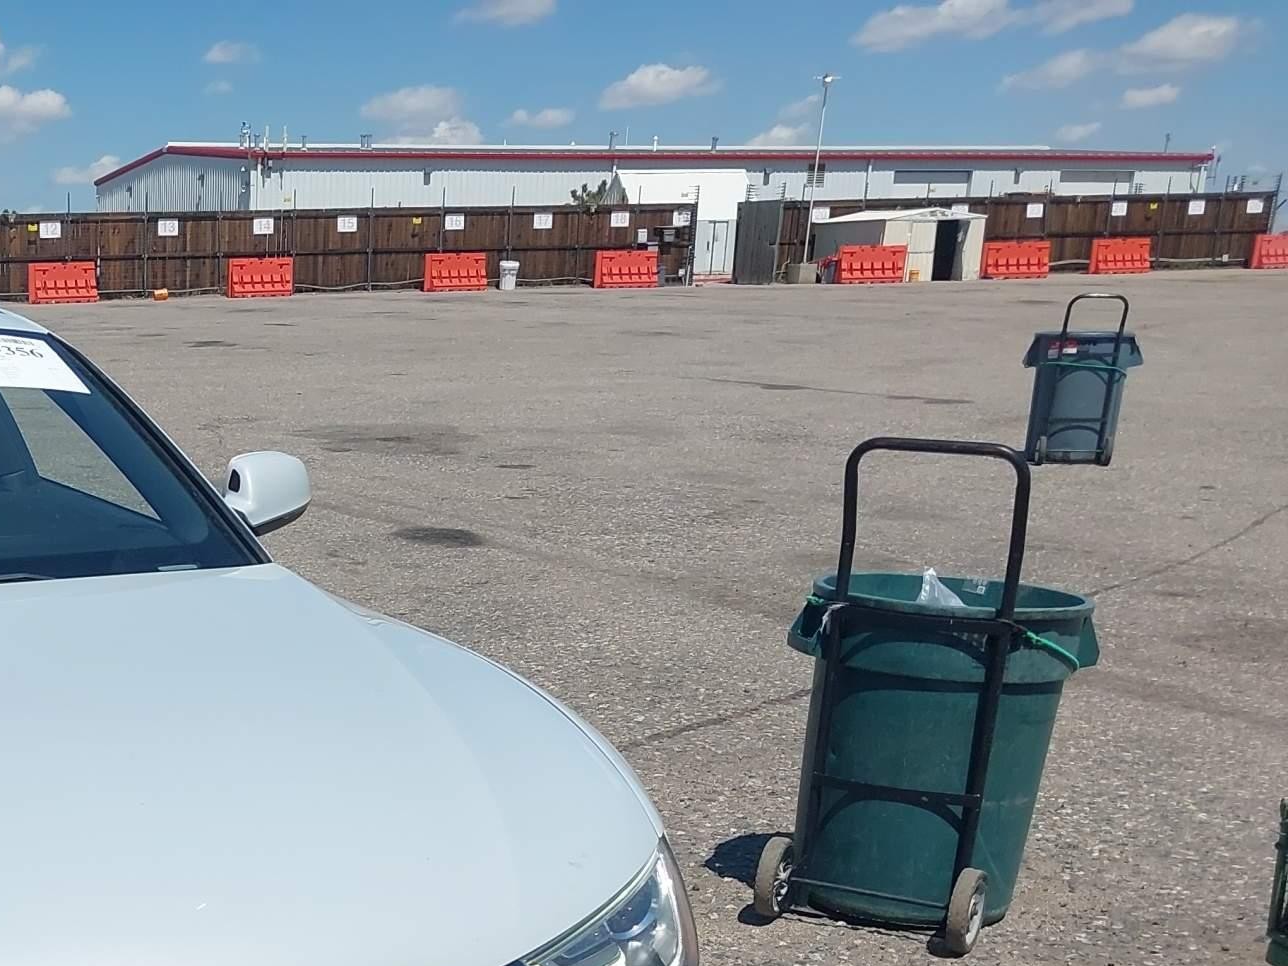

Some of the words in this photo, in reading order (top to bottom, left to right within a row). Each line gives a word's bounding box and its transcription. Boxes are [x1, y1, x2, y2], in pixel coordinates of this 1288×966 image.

[340, 218, 354, 229] 15
[447, 216, 461, 227] 16
[537, 215, 550, 225] 17
[44, 223, 58, 236] 12
[160, 222, 175, 233] 13
[258, 220, 271, 232] 14
